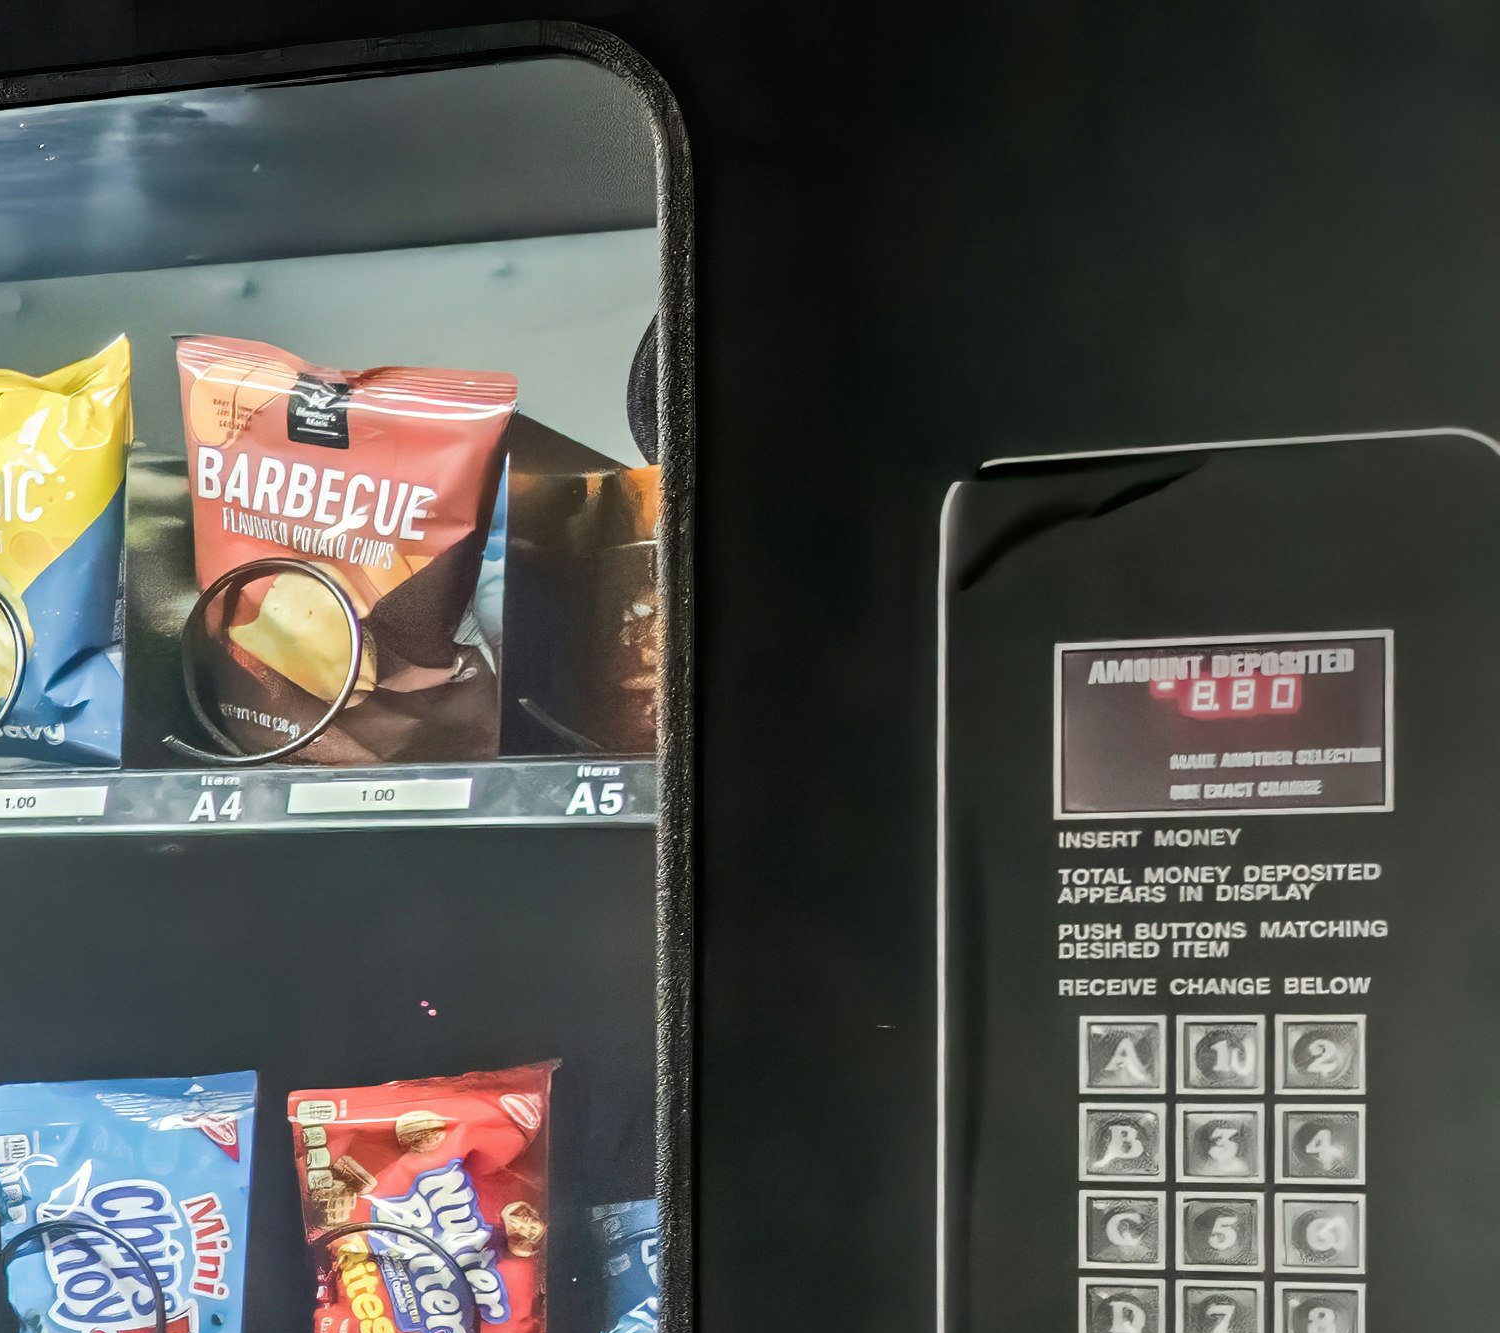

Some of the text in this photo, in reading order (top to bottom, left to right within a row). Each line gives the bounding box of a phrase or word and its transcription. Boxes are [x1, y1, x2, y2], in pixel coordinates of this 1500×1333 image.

[197, 446, 437, 541] BARBECUE
[222, 506, 395, 570] FLAVORED POTATO CHIPS
[1088, 649, 1354, 684] AMOUNT DEPOSITED
[3, 795, 37, 809] 1.00
[189, 788, 396, 822] A4 1.00
[565, 784, 623, 814] A5
[1058, 828, 1241, 849] INSERT MONEY
[1058, 863, 1381, 885] TOTAL MONEY DEPOSITED
[1058, 883, 1316, 905] APPEARS IN DISPLAY
[1058, 920, 1388, 941] PUSH BUTTONS MATCHING
[1058, 941, 1229, 959] DESIRED ITEM
[1058, 977, 1371, 996] RECEIVE CHANGE BELOW
[91, 1185, 179, 1316] Chips
[184, 1198, 231, 1298] Mini
